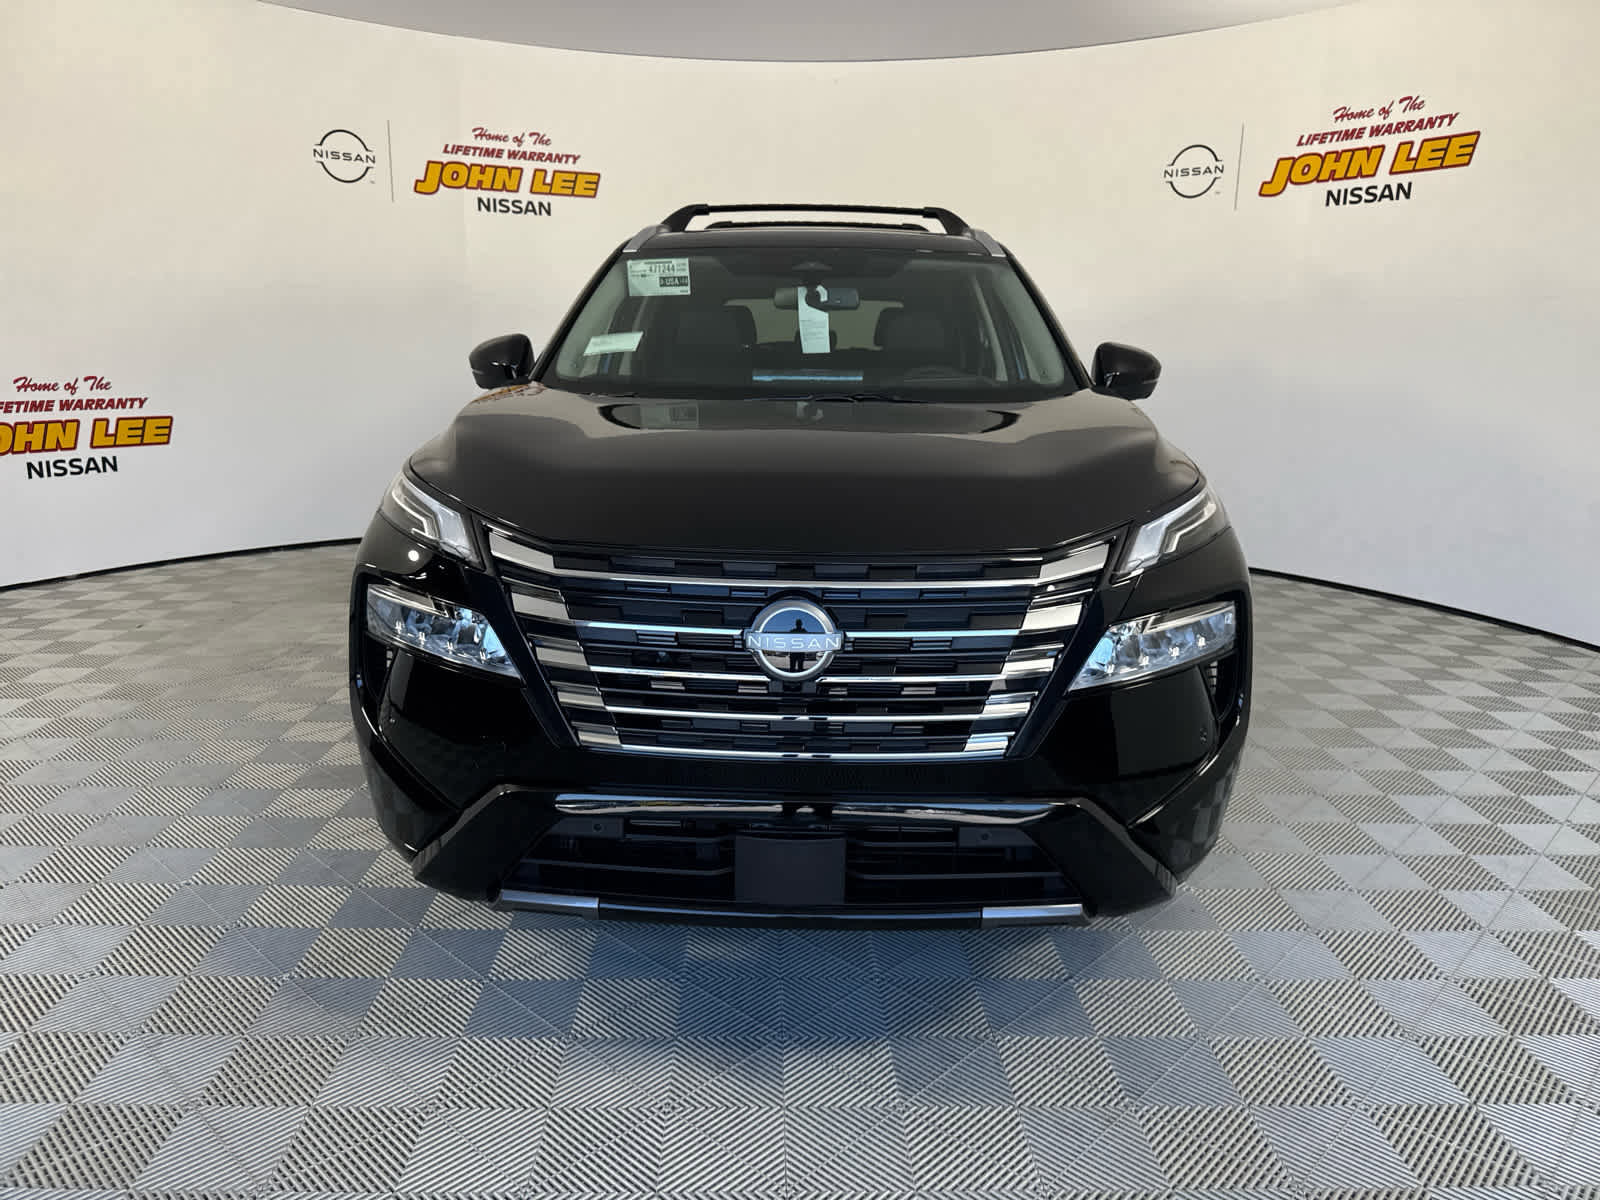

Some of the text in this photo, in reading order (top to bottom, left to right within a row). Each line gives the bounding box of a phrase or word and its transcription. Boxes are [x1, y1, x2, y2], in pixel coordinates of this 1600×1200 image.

[1333, 95, 1425, 123] Home of The
[471, 127, 551, 146] Home of The
[1296, 112, 1460, 147] LIFETIME WARRANTY
[312, 148, 376, 165] NISSAN
[442, 144, 581, 165] LIFETIME WARRANTY
[1258, 131, 1481, 198] JOHN LEE
[414, 160, 601, 199] JOHN LEE
[1163, 164, 1225, 179] NISSAN
[1325, 181, 1413, 207] NISSAN
[476, 196, 552, 217] NISSAN
[13, 375, 113, 395] Home of The
[59, 397, 148, 411] WARRANTY
[90, 415, 174, 449] LEE
[26, 455, 119, 480] NISSAN
[748, 635, 840, 649] NISSAN
